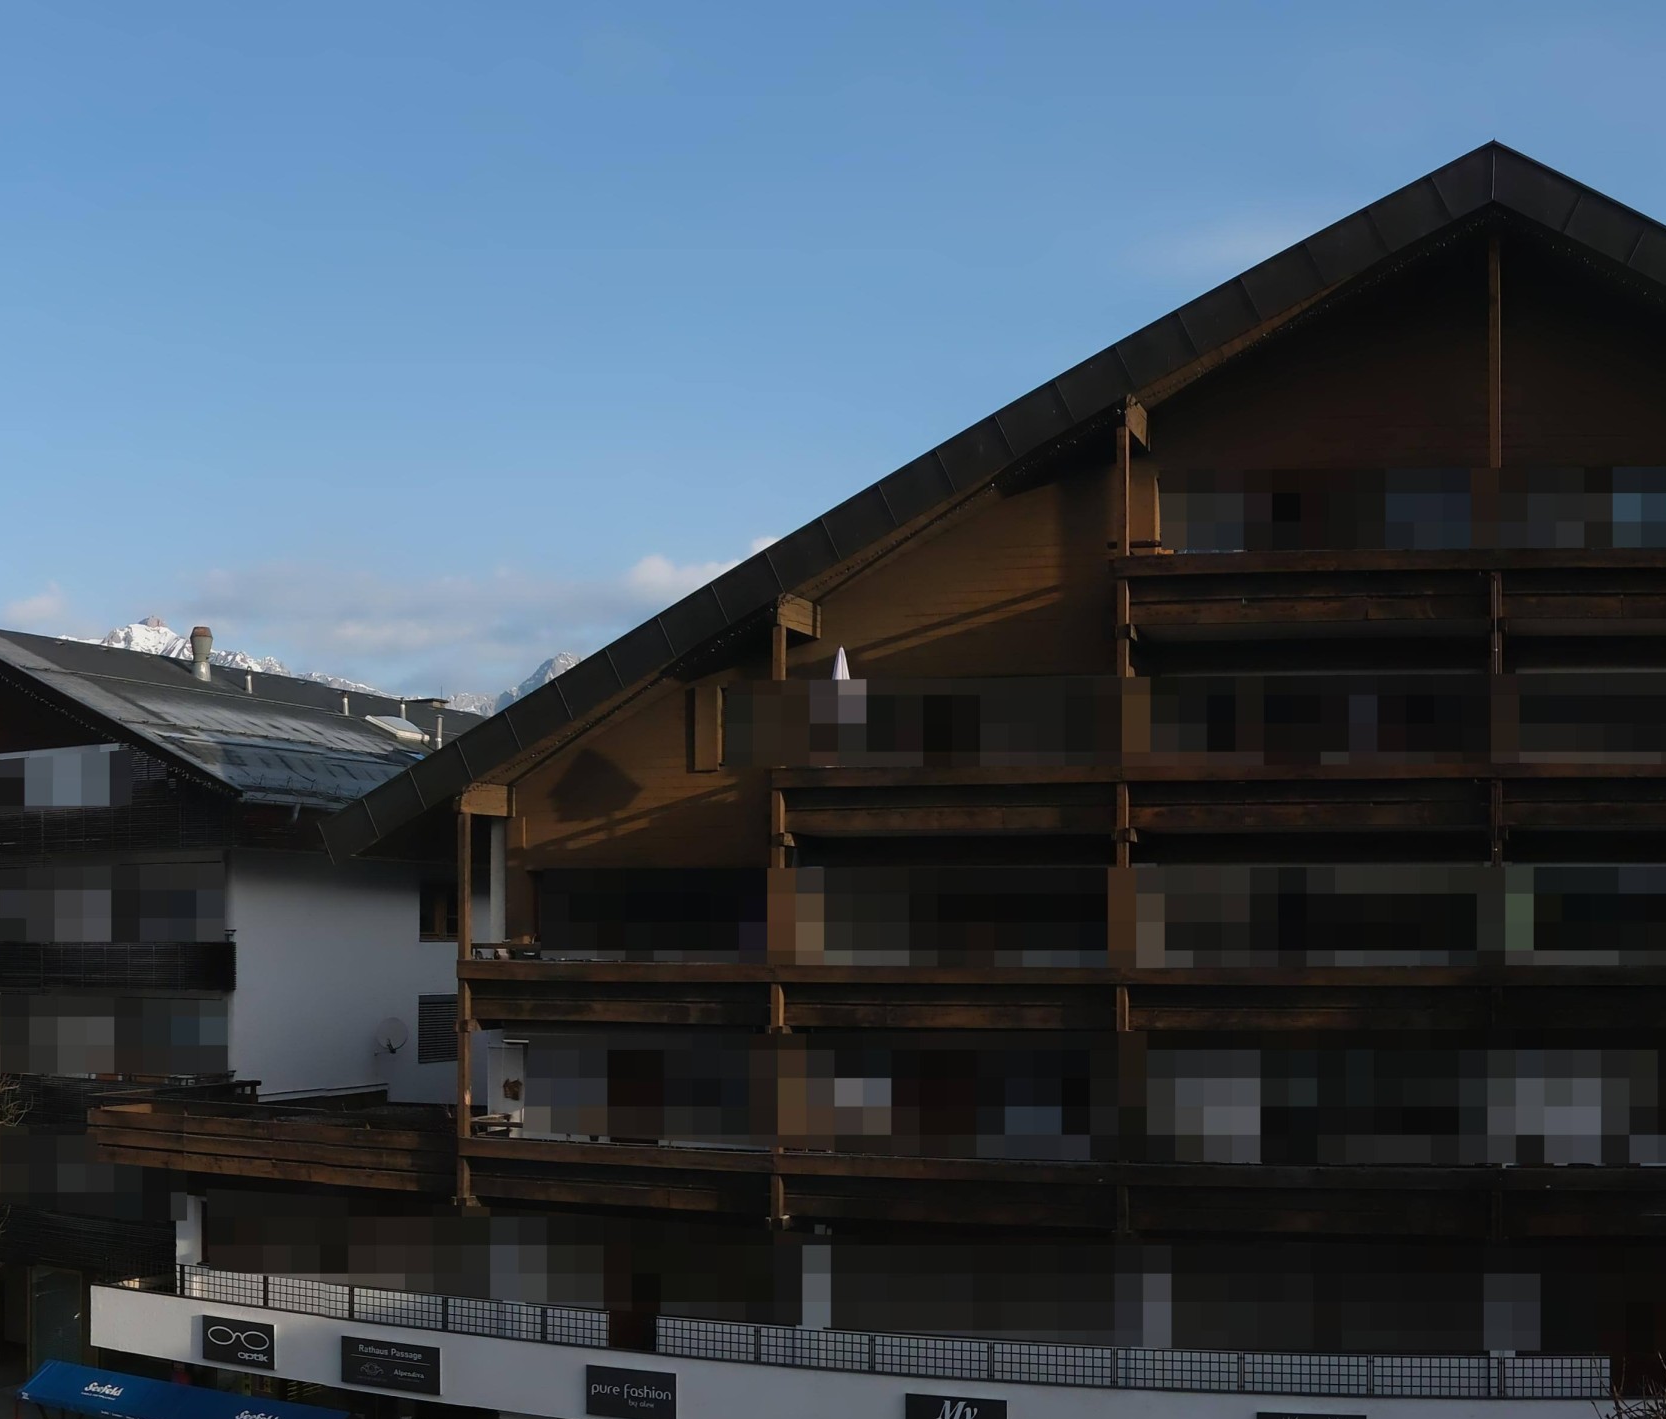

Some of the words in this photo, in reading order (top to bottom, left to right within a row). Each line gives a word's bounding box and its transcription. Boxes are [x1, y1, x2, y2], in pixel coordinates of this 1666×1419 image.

[237, 1351, 269, 1363] optik
[591, 1384, 620, 1396] pure
[624, 1384, 671, 1400] fashion
